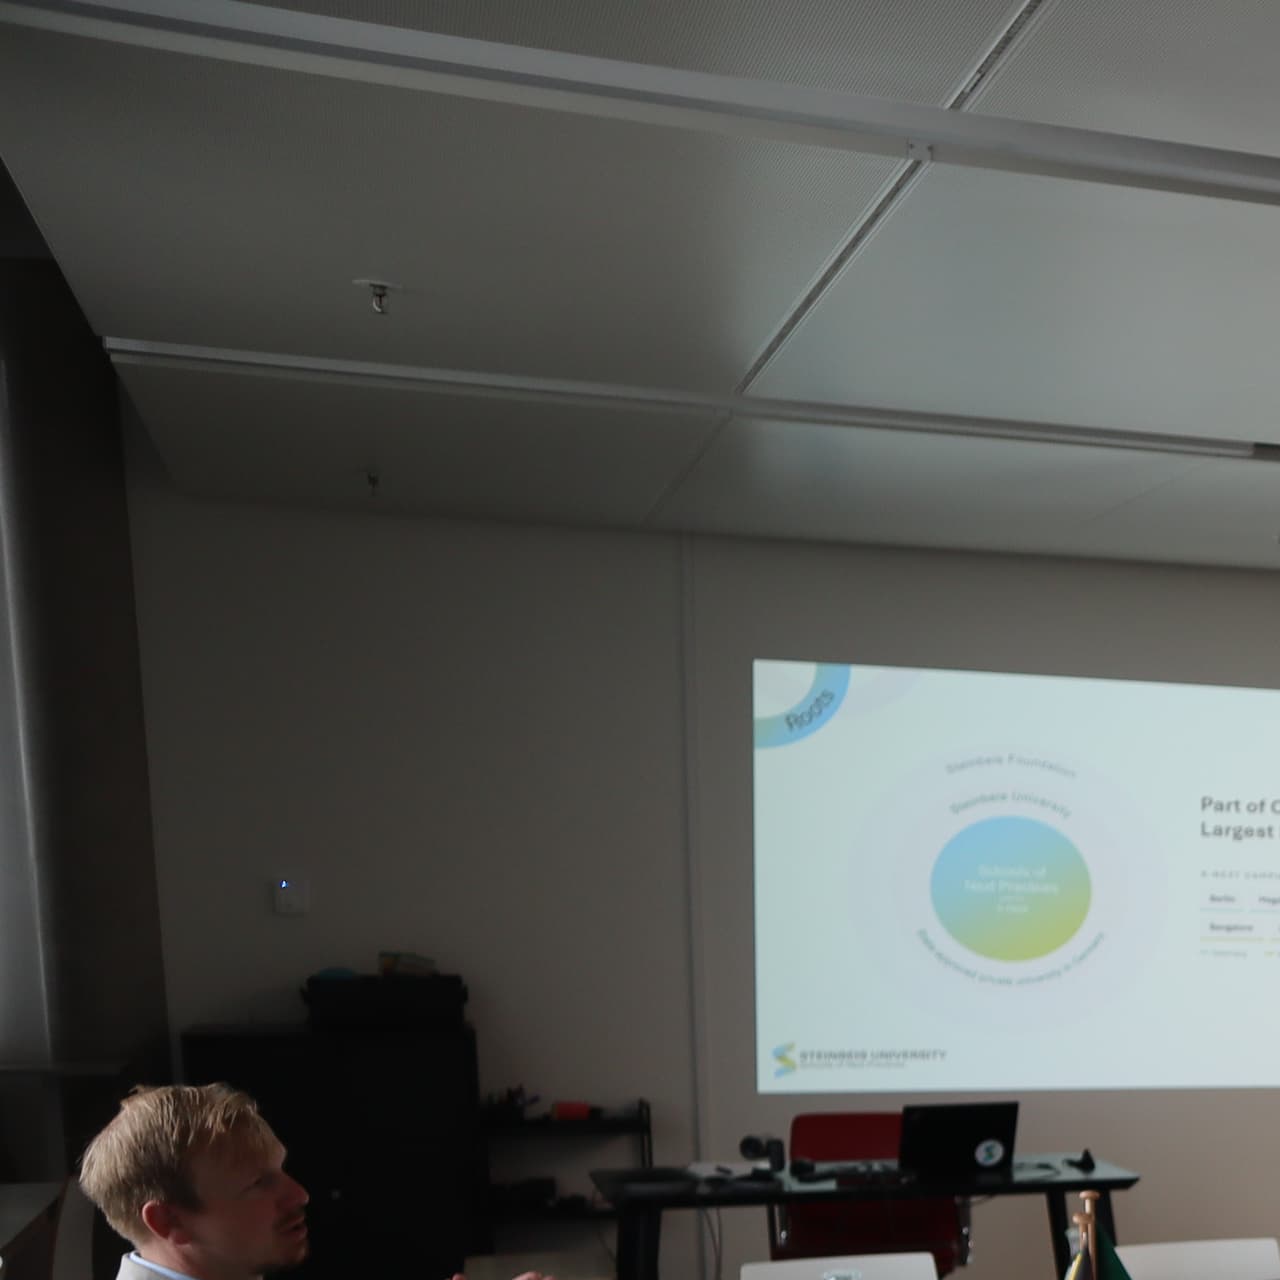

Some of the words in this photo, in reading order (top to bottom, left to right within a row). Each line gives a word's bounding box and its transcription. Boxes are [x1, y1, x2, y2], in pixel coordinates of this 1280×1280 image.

[784, 689, 835, 733] Roots
[1200, 796, 1241, 814] Part
[1246, 798, 1266, 815] of
[1200, 821, 1274, 842] Largest
